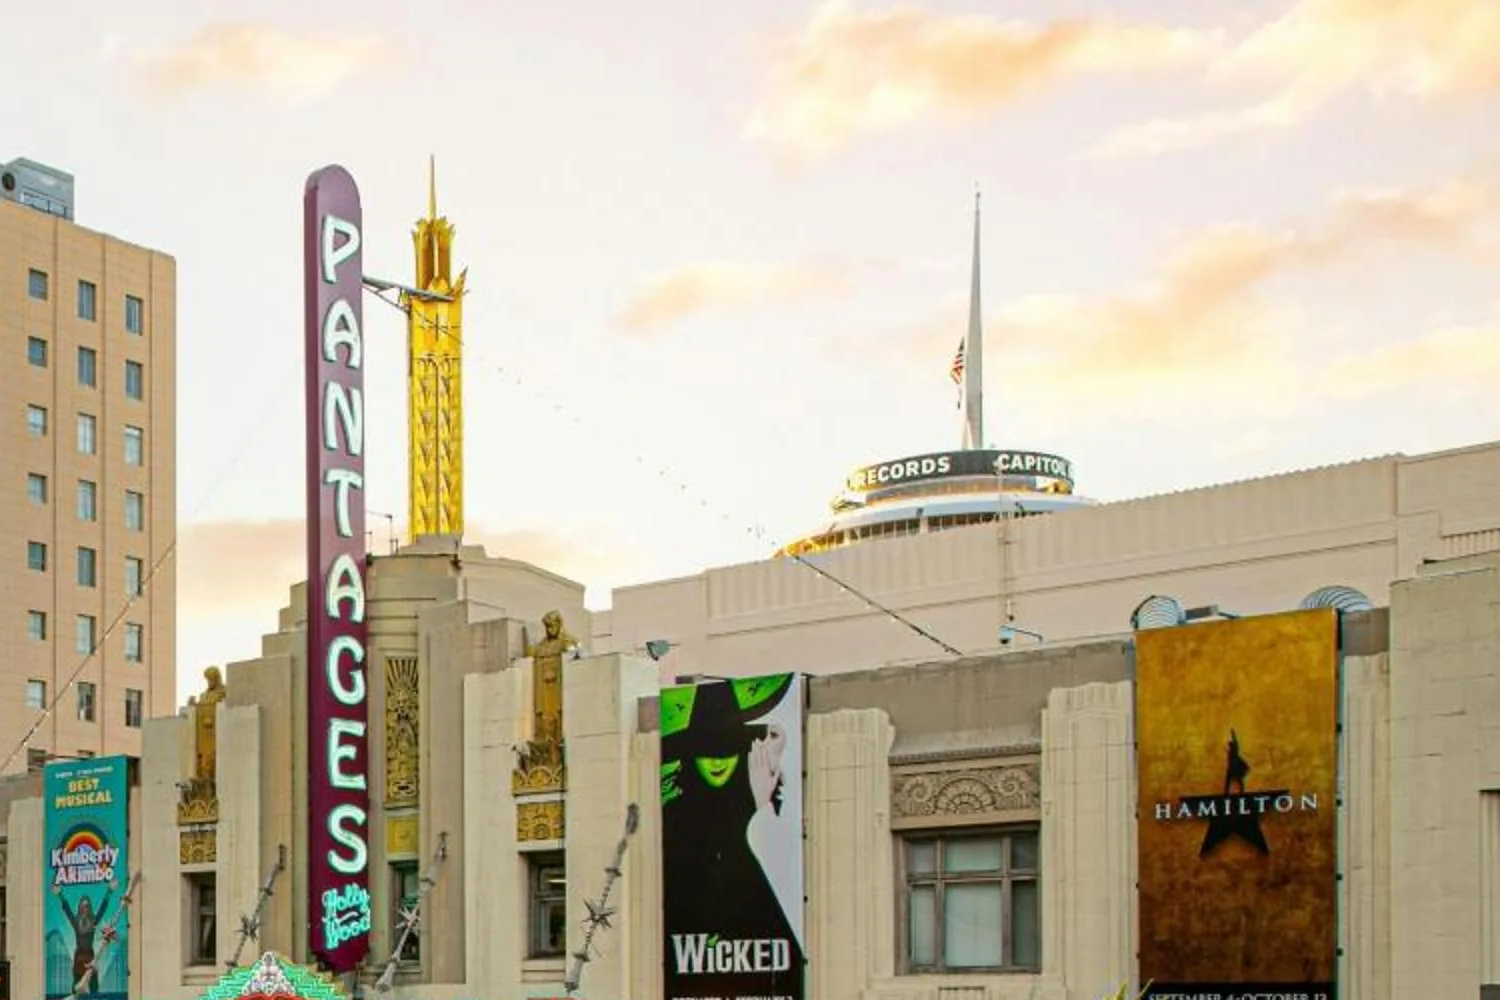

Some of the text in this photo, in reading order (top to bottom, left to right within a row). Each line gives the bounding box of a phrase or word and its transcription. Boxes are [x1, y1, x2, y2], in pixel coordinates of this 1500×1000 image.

[854, 456, 950, 487] RECORDS
[998, 453, 1068, 477] CAPITOL
[321, 214, 367, 874] PANTAGES
[68, 777, 100, 793] BEST
[55, 789, 113, 809] MUSICAL
[1155, 794, 1317, 820] HAMILTON
[51, 844, 120, 868] Kimberly
[55, 863, 116, 885] Akimbo
